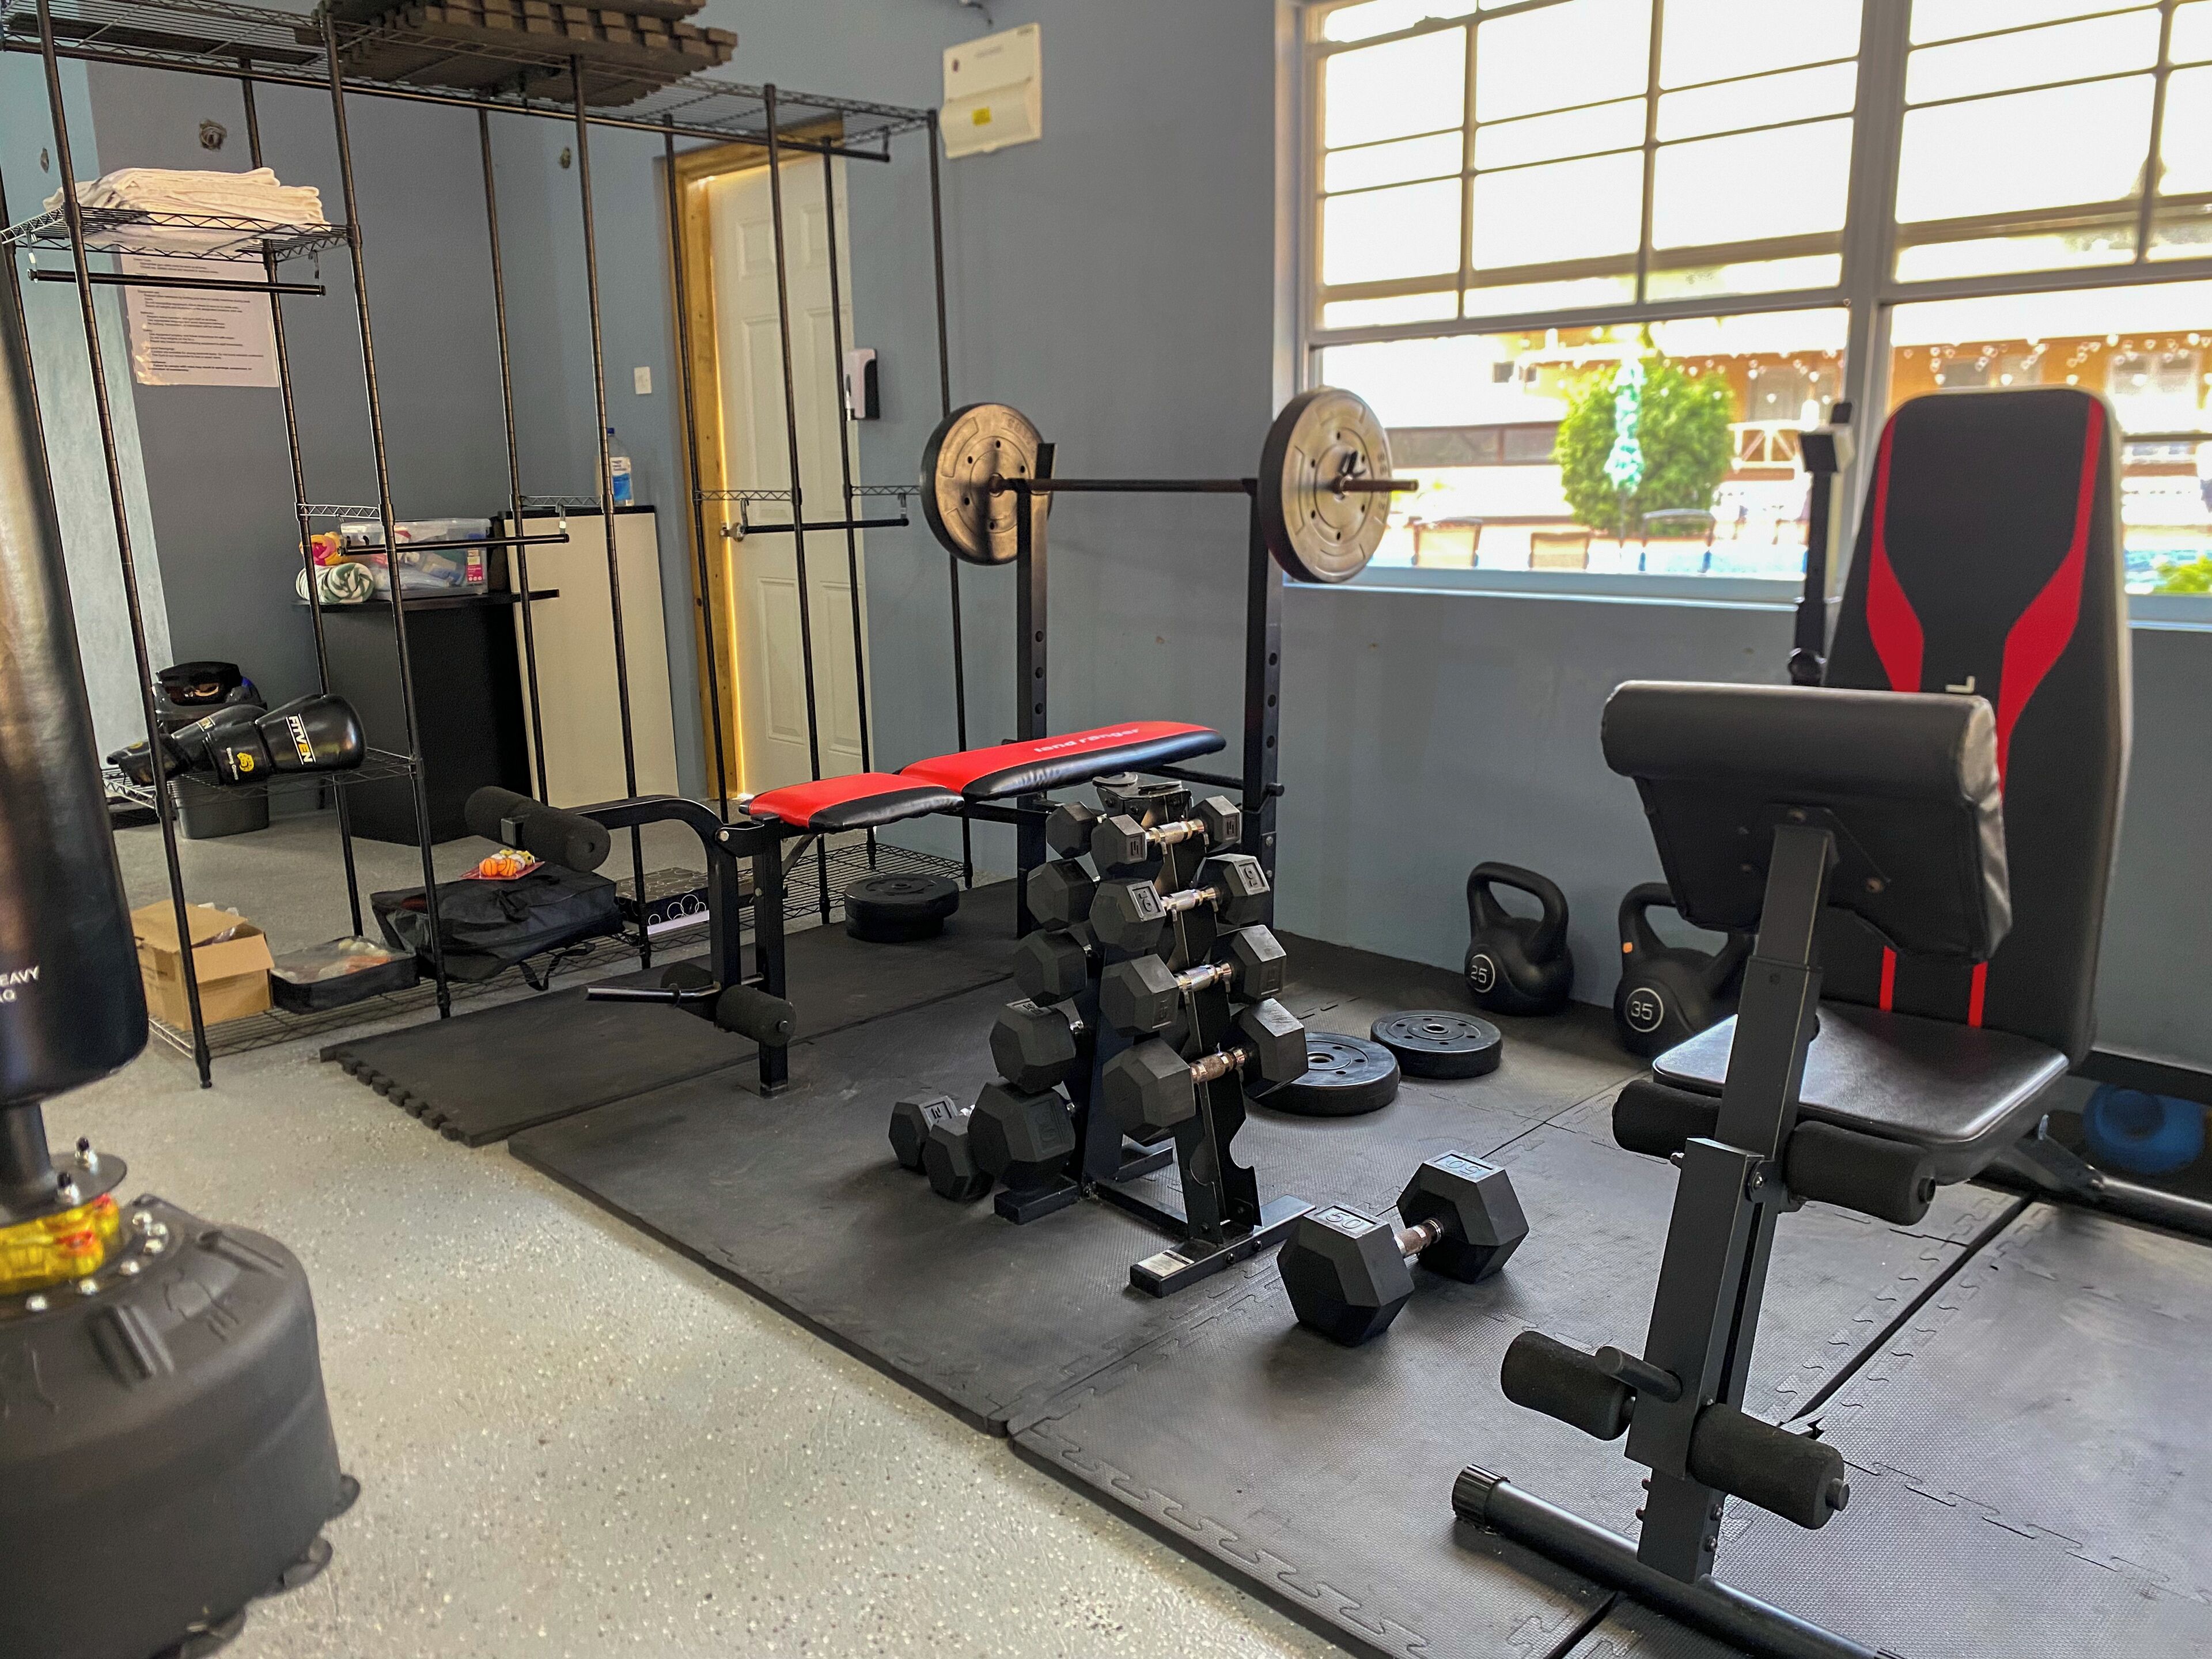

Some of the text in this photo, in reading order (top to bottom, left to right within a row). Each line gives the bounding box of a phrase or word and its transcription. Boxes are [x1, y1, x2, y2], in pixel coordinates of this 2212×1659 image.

[288, 715, 313, 763] FITVEN
[1033, 728, 1139, 753] land ranger
[1245, 865, 1259, 888] 10
[1138, 889, 1153, 913] 10
[1470, 965, 1488, 984] 25
[1630, 1000, 1654, 1021] 35
[1444, 1157, 1484, 1176] 50
[1324, 1211, 1365, 1230] 50
